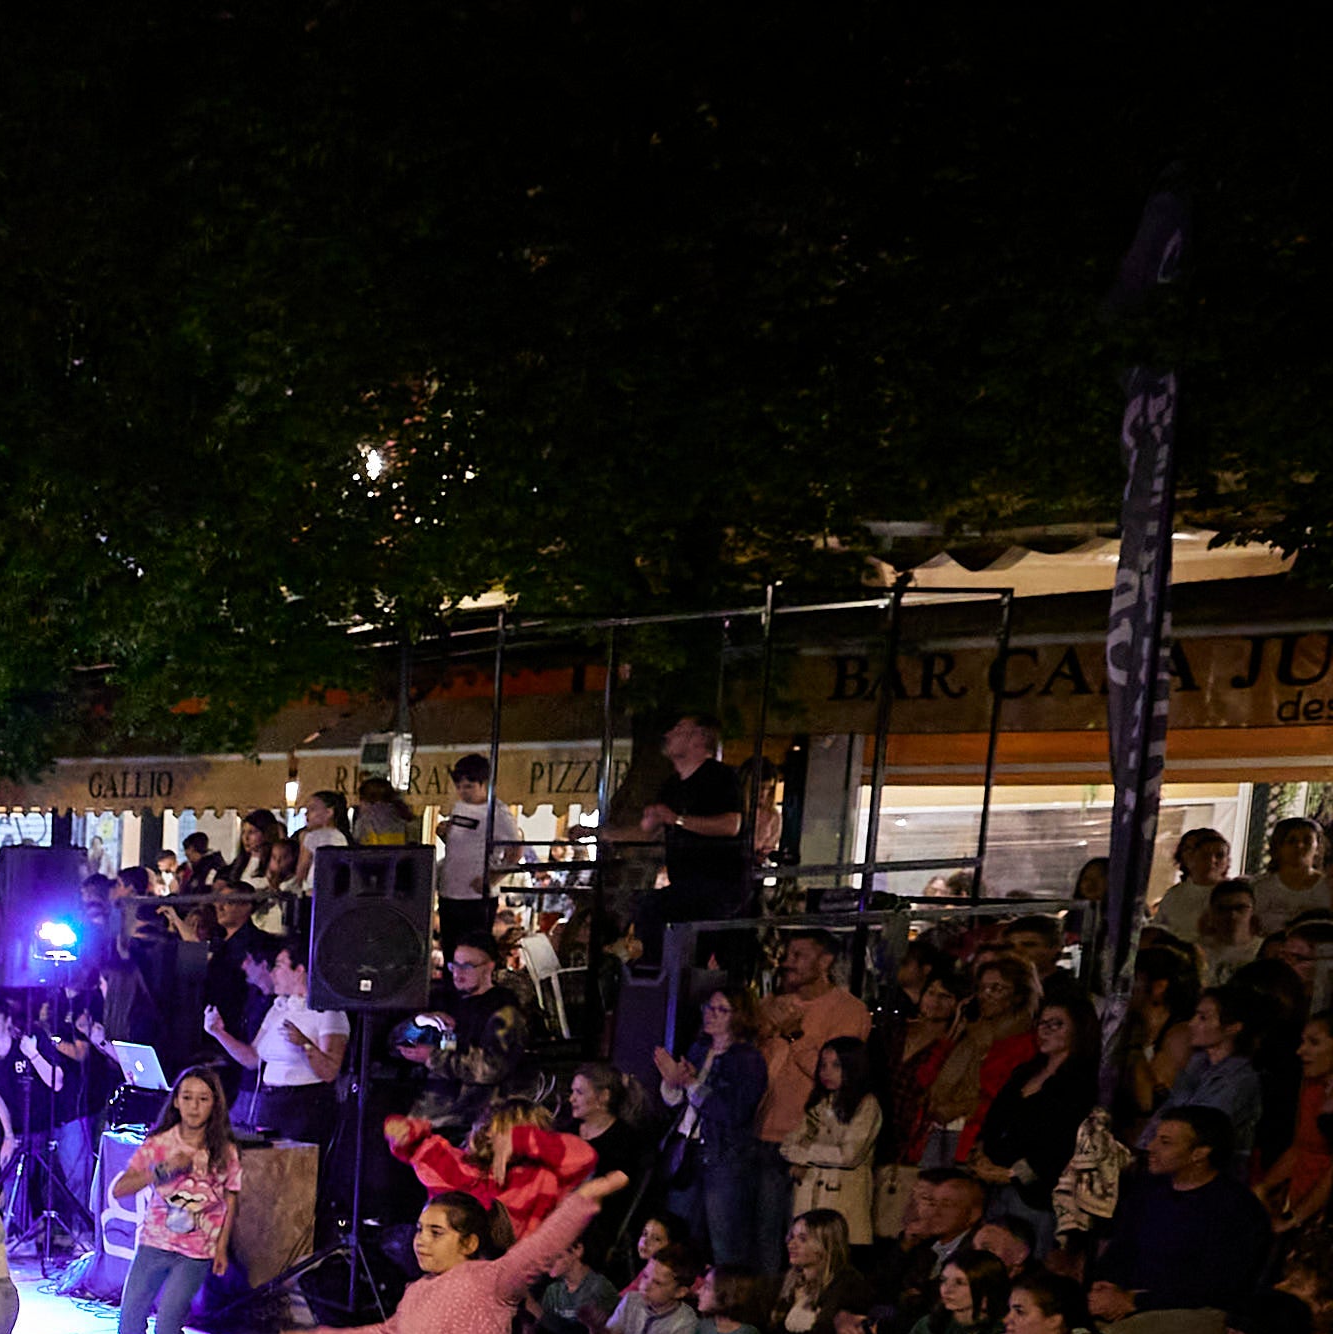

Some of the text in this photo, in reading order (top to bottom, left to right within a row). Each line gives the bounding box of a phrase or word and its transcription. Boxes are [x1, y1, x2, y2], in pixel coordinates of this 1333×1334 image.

[827, 652, 967, 701] BAR
[988, 644, 1201, 699] CAA
[88, 771, 174, 799] GALLIO
